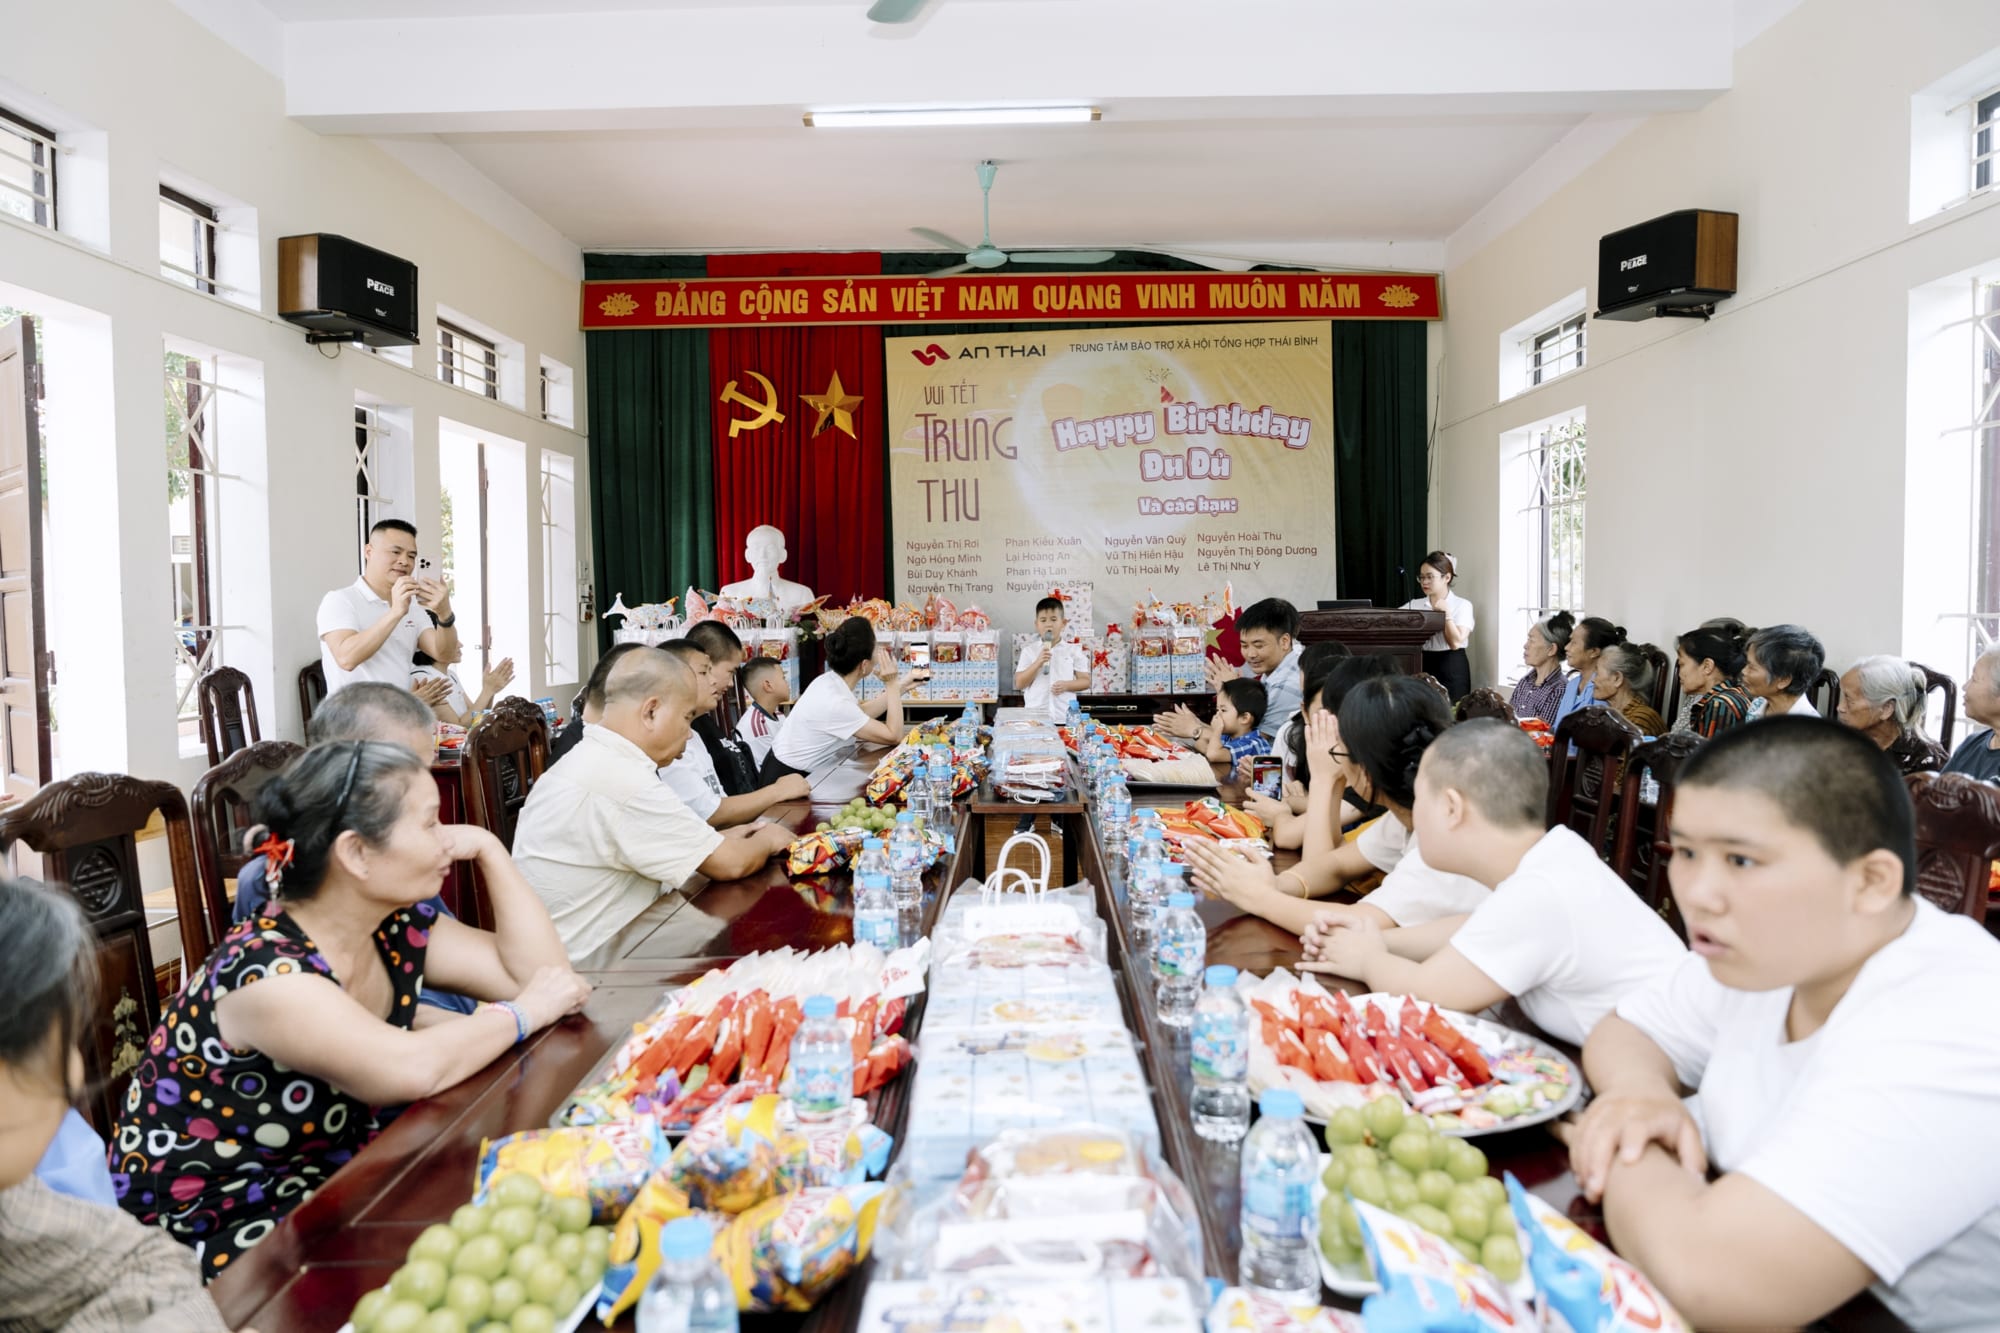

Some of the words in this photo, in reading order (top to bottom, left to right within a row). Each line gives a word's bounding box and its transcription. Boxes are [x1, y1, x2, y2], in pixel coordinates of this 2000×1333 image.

[1620, 254, 1648, 272] PEACE
[366, 278, 395, 296] PEACE
[655, 282, 726, 316] ĐẢNG
[739, 283, 809, 320] CỘNG
[822, 279, 877, 314] SẢN
[891, 281, 945, 318] VIỆT
[958, 286, 1019, 311] NAM
[1032, 284, 1122, 313] QUANG
[1135, 284, 1196, 309] VINH
[1209, 277, 1286, 309] MUÔN
[1299, 277, 1361, 309] NĂM
[1069, 343, 1104, 353] TRUNG
[1106, 340, 1129, 352] TÂM
[1131, 340, 1152, 351] BẢO
[1154, 340, 1175, 352] TRỢ
[1177, 338, 1191, 350] XÃ
[1193, 337, 1211, 350] HỘI
[1214, 336, 1242, 349] TỔNG
[1244, 337, 1266, 349] HỢP
[1269, 336, 1292, 347] THÁI
[1294, 335, 1318, 346] BÌNH
[958, 346, 990, 360] AN
[995, 344, 1046, 358] THAI
[950, 378, 978, 404] TẾT
[1052, 411, 1156, 451] Happy
[1164, 402, 1311, 449] Birthday
[915, 413, 1018, 462] TRUNG
[917, 478, 980, 522] THU
[1138, 496, 1162, 515] Và
[1163, 497, 1196, 515] các
[1005, 537, 1030, 547] Phan
[1056, 536, 1082, 546] Xuân
[1105, 534, 1143, 548] Nguyễn
[1145, 535, 1164, 545] Văn
[1197, 531, 1235, 544] Nguyễn
[1263, 531, 1282, 541] Thu
[946, 540, 962, 551] Thị
[1197, 546, 1236, 559] Nguyễn
[1238, 546, 1254, 558] Thị
[1285, 545, 1317, 556] Dương
[958, 554, 982, 563] Minh
[1121, 550, 1137, 562] Thị
[1049, 566, 1067, 575] Lan
[1122, 565, 1137, 576] Thị
[1198, 561, 1210, 572] Lê
[1212, 561, 1228, 573] Thị
[1230, 561, 1251, 571] Như
[925, 569, 944, 580] Duy
[947, 583, 963, 594] Thị
[965, 583, 993, 594] Trang
